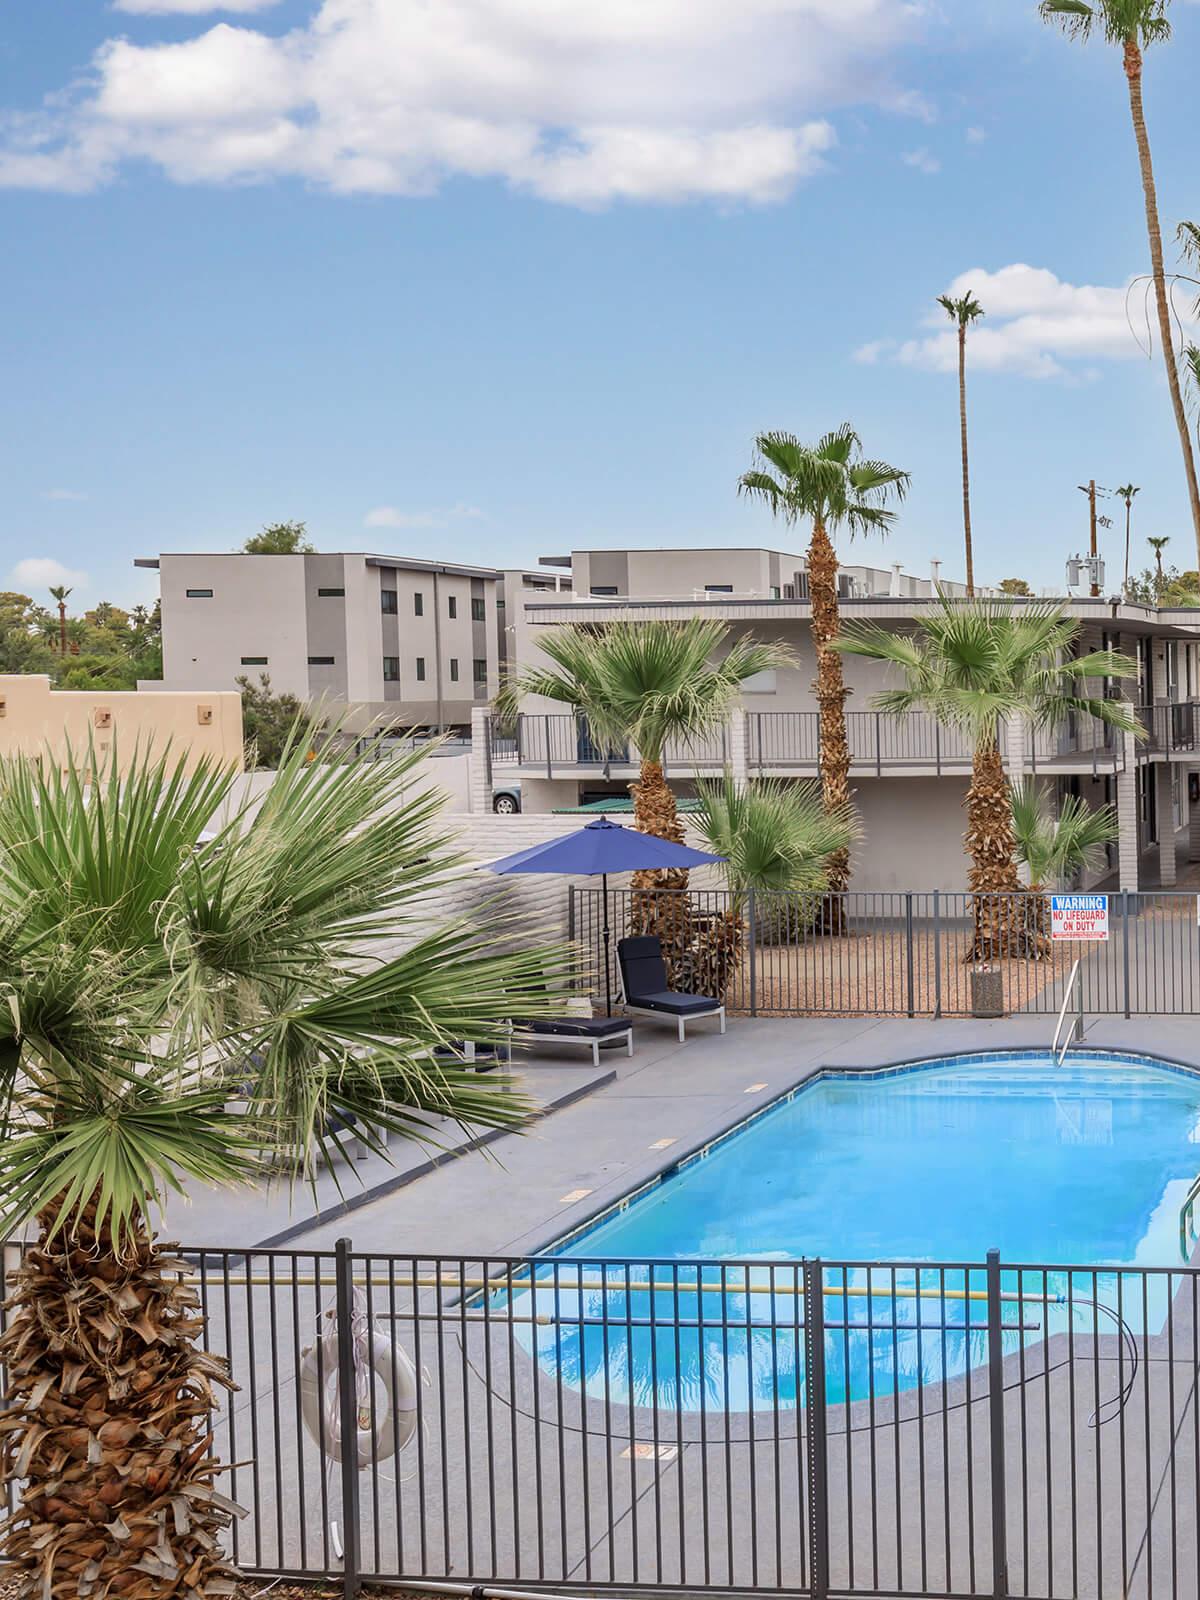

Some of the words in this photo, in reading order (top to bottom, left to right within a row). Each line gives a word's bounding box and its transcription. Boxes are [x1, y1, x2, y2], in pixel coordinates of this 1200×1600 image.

[1055, 897, 1103, 909] WARNING
[1053, 911, 1063, 920] NO
[1066, 911, 1105, 920] LIFEGUARD
[1063, 921, 1073, 931] ON
[1076, 921, 1095, 931] DUTY
